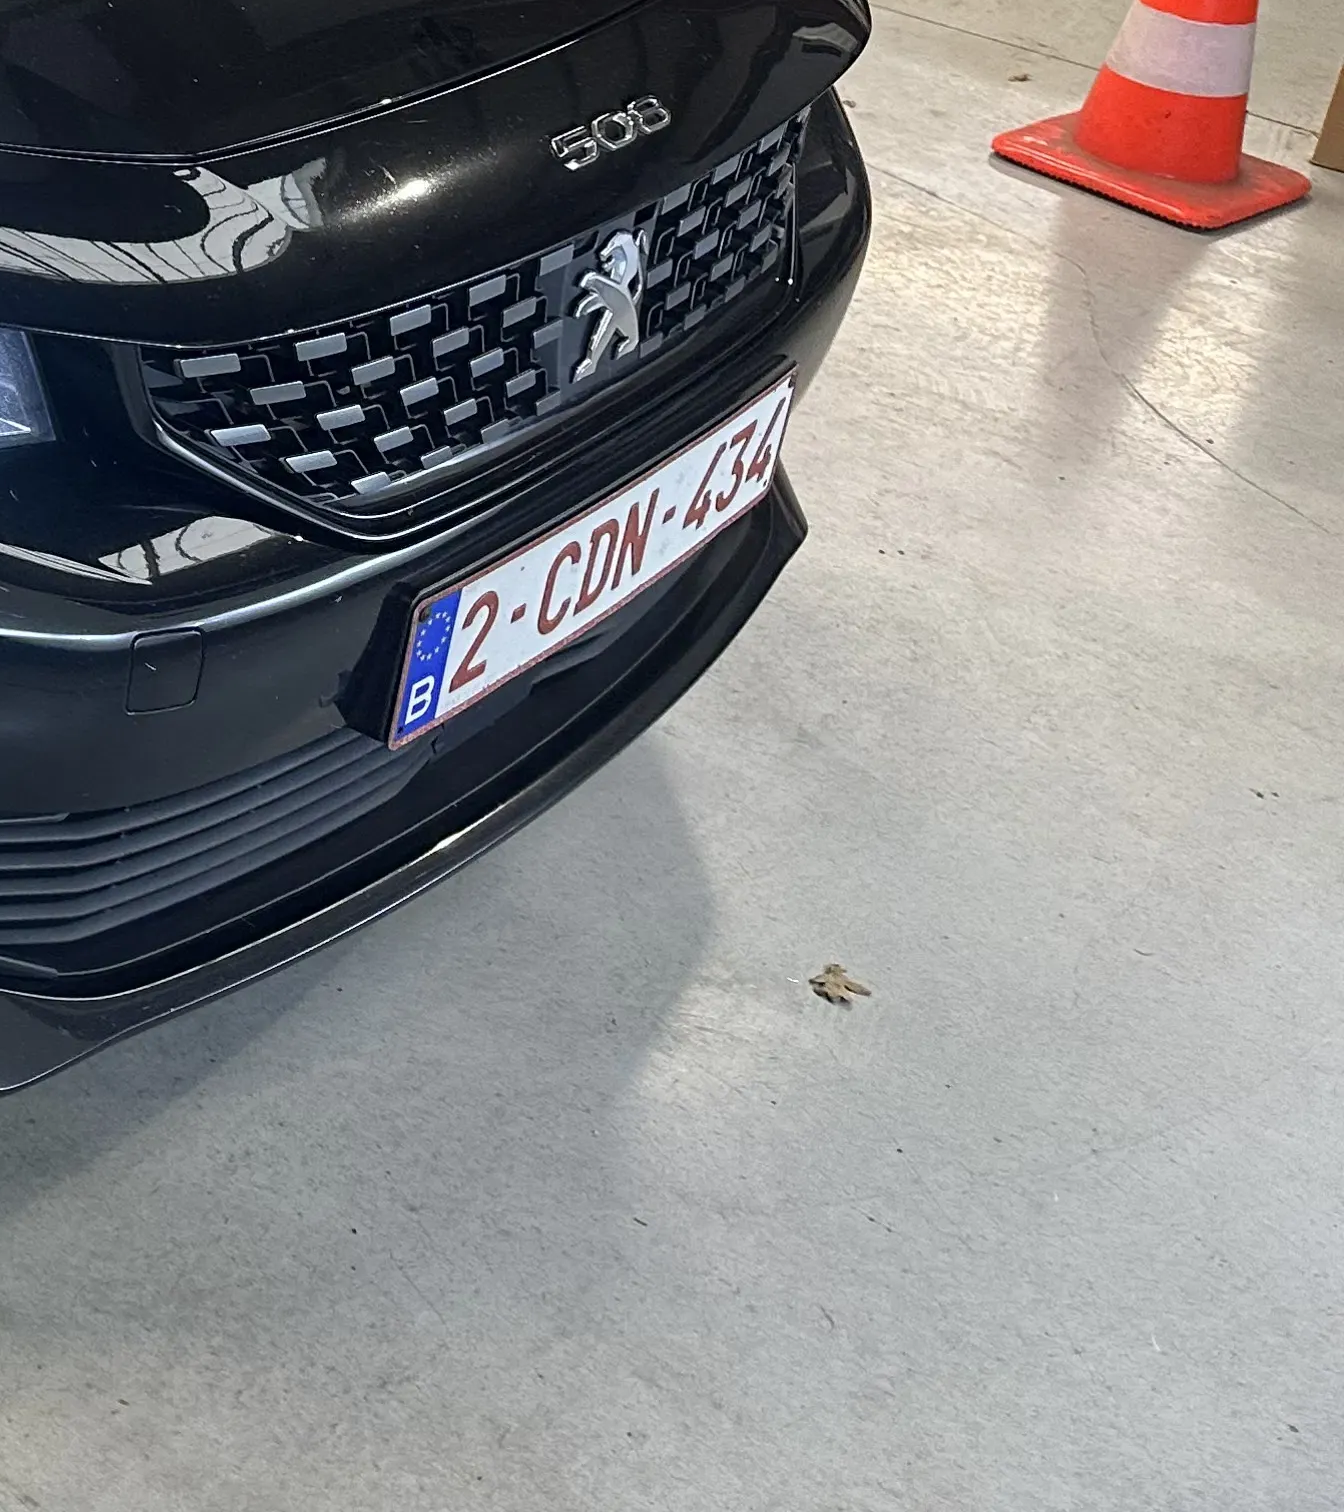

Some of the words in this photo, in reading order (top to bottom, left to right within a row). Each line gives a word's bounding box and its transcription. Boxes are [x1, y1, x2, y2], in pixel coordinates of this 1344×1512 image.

[550, 95, 672, 172] 508
[449, 397, 787, 693] 2-CDN-434
[404, 675, 435, 726] B
